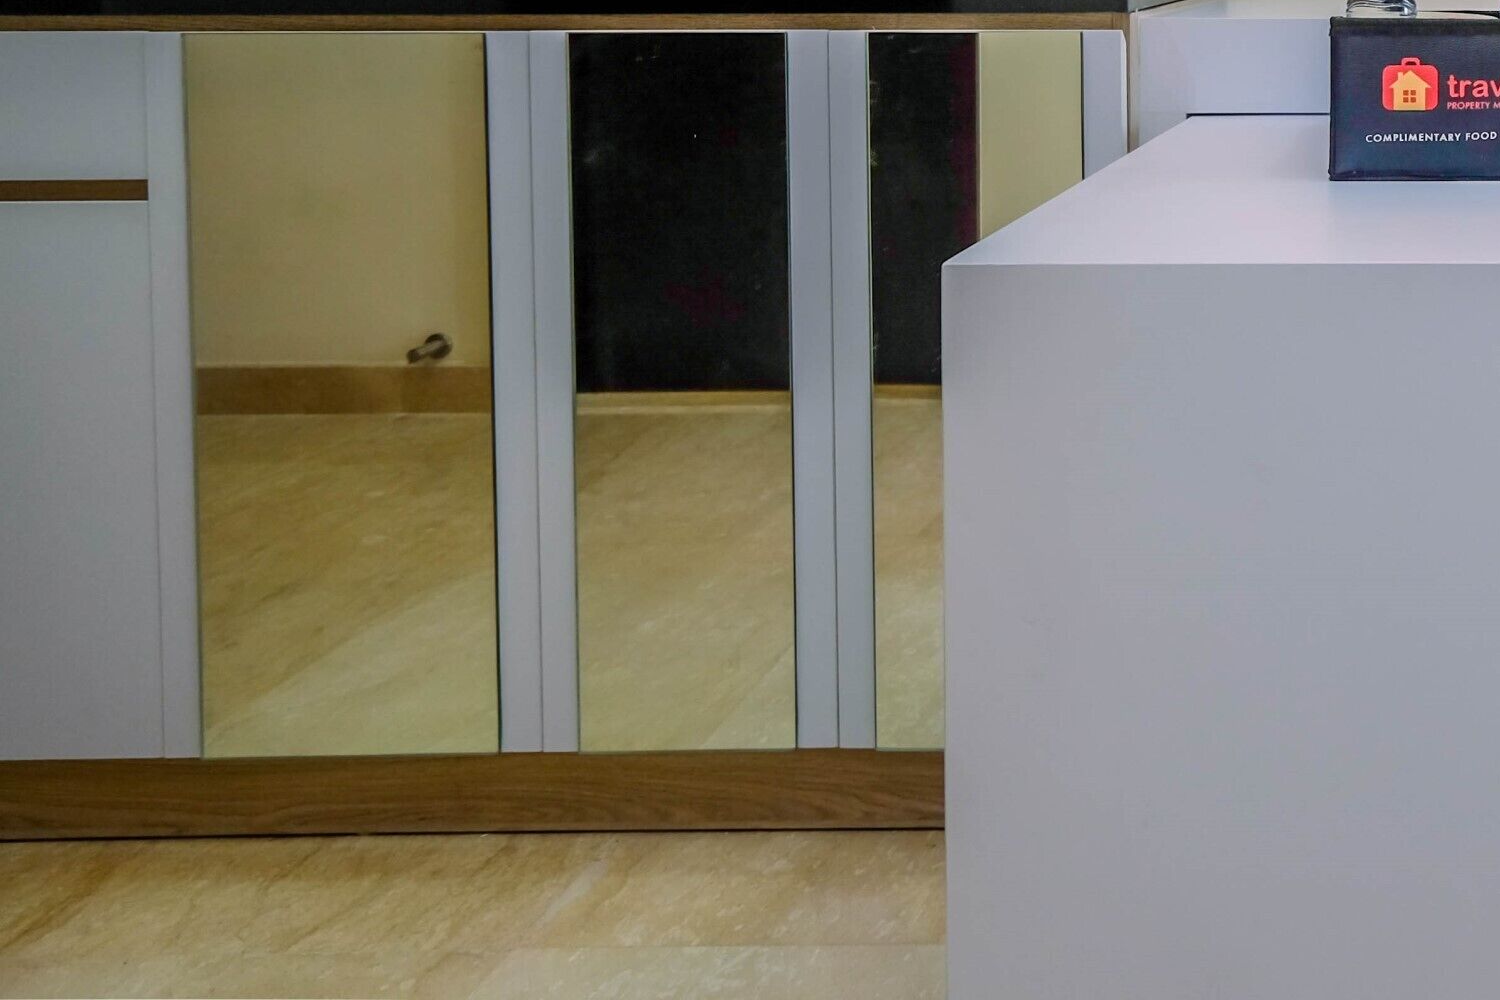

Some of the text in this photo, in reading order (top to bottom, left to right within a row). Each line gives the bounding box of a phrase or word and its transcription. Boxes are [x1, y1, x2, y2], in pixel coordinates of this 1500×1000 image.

[1446, 101, 1490, 111] PROPERTY
[1365, 132, 1462, 143] COMPLIMENTARY
[1465, 131, 1497, 141] FOOD
